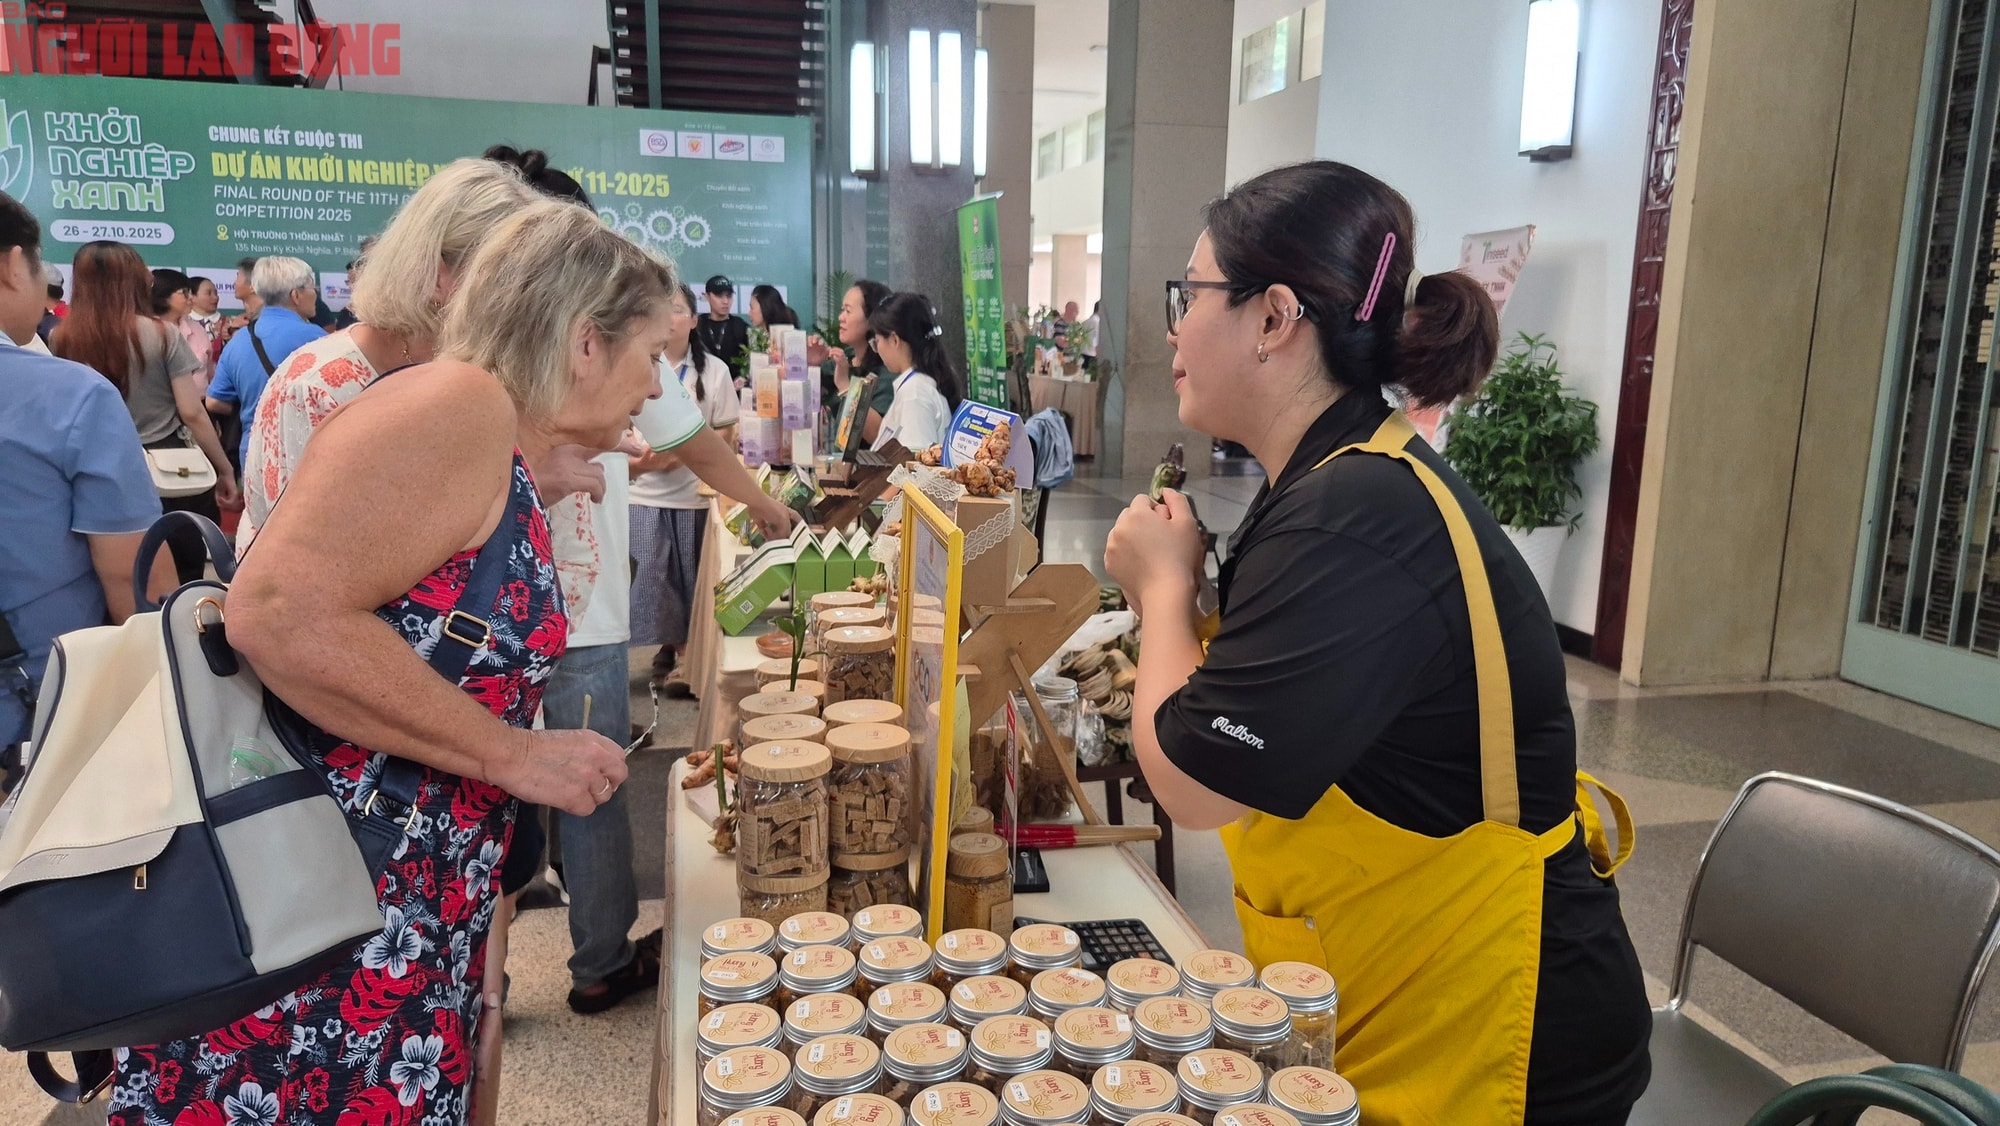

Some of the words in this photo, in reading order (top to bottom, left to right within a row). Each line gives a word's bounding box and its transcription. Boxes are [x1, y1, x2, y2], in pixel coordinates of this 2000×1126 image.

[45, 107, 142, 145] KHỞI
[208, 125, 260, 144] CHUNG
[264, 124, 290, 146] KẾT
[294, 129, 334, 150] CUỘC
[338, 133, 362, 149] THI
[48, 143, 196, 184] NGHIỆP
[212, 150, 247, 182] DỰ
[250, 150, 282, 180] ÁN
[286, 152, 344, 183] KHỞI
[52, 179, 165, 213] XANH
[214, 184, 258, 200] FINAL
[262, 187, 312, 202] ROUND
[316, 190, 334, 203] OF
[338, 190, 366, 204] THE
[370, 192, 398, 206] 11TH
[585, 170, 671, 198] 11-2025
[216, 203, 314, 220] COMPETITION
[317, 208, 352, 222] 2025
[63, 226, 80, 236] 26
[92, 226, 162, 239] 27.10.2025
[234, 229, 250, 240] HỘI
[250, 244, 272, 252] Nam
[1212, 716, 1264, 750] Malbon
